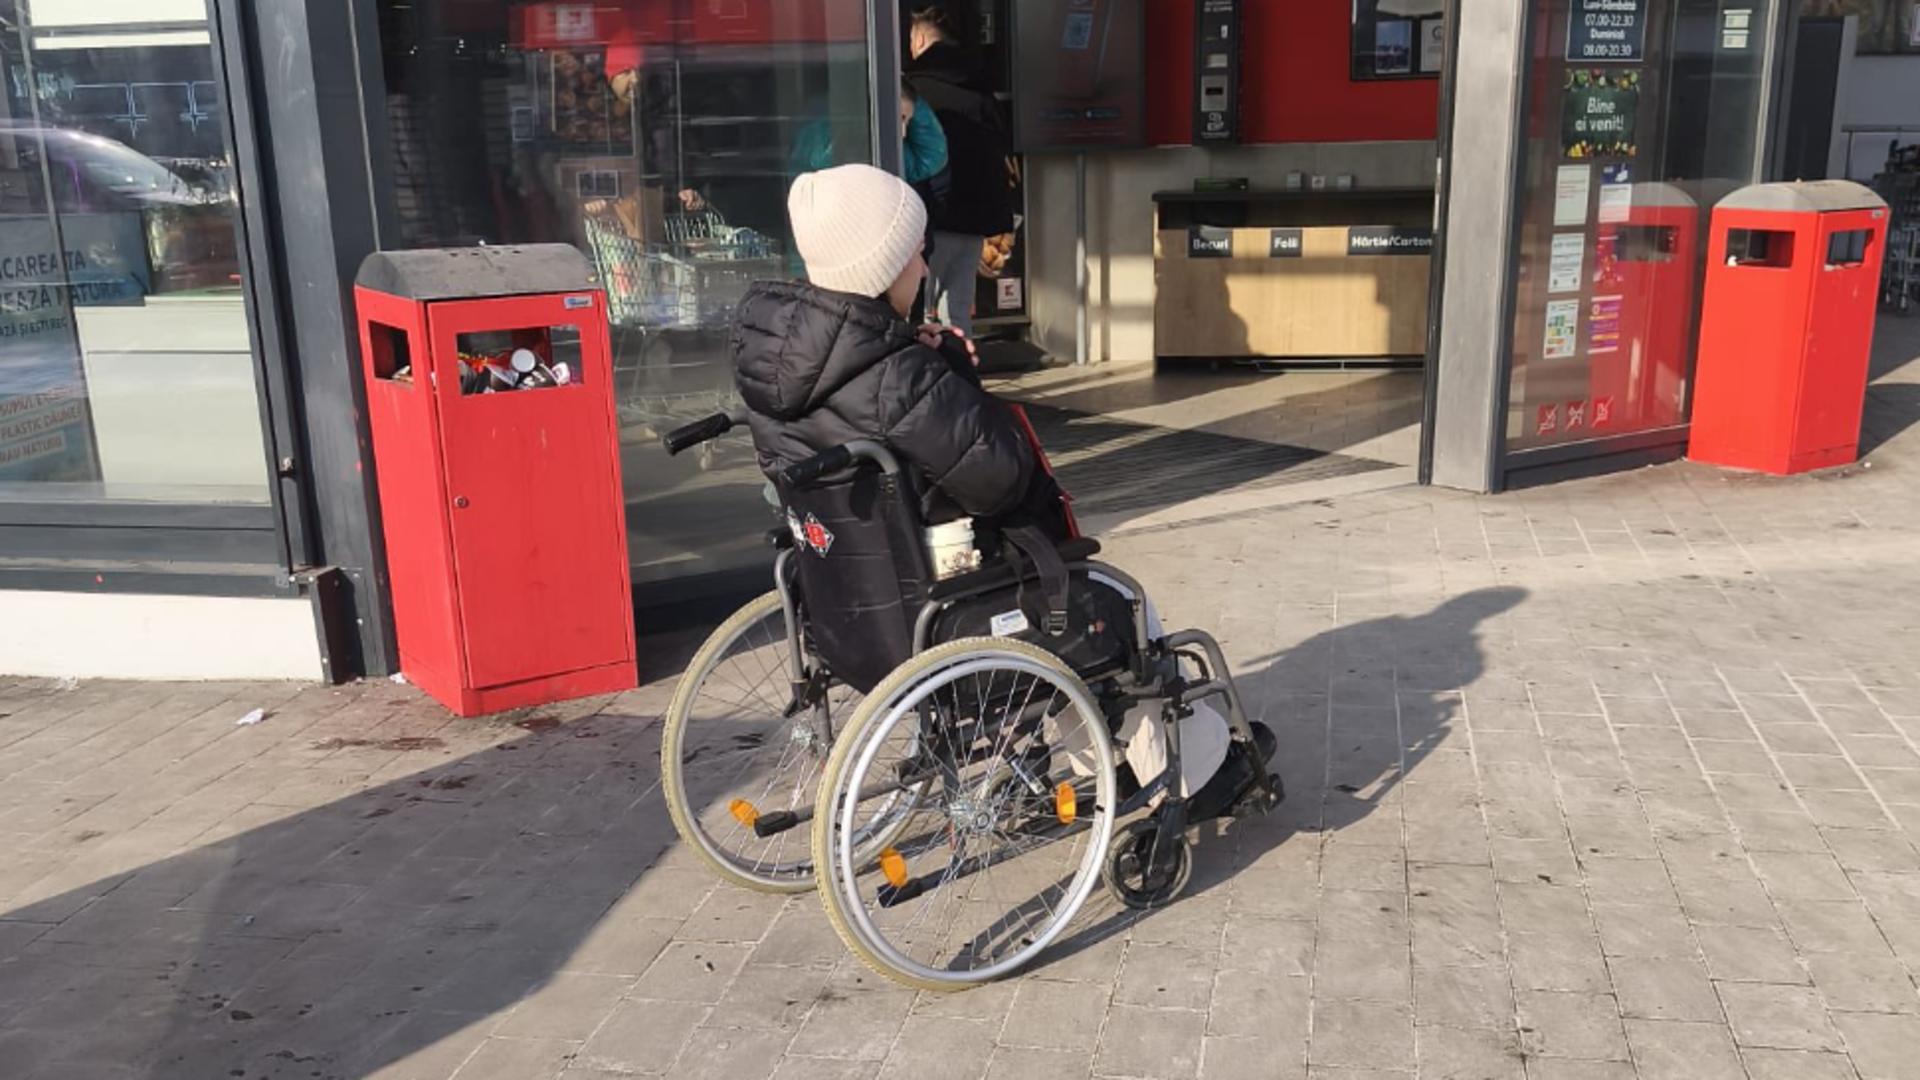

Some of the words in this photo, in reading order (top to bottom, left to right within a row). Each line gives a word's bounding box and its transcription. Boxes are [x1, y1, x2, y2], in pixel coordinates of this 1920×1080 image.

[1587, 97, 1616, 114] Bine
[1589, 115, 1624, 131] venit!
[0, 253, 58, 279] CAREA
